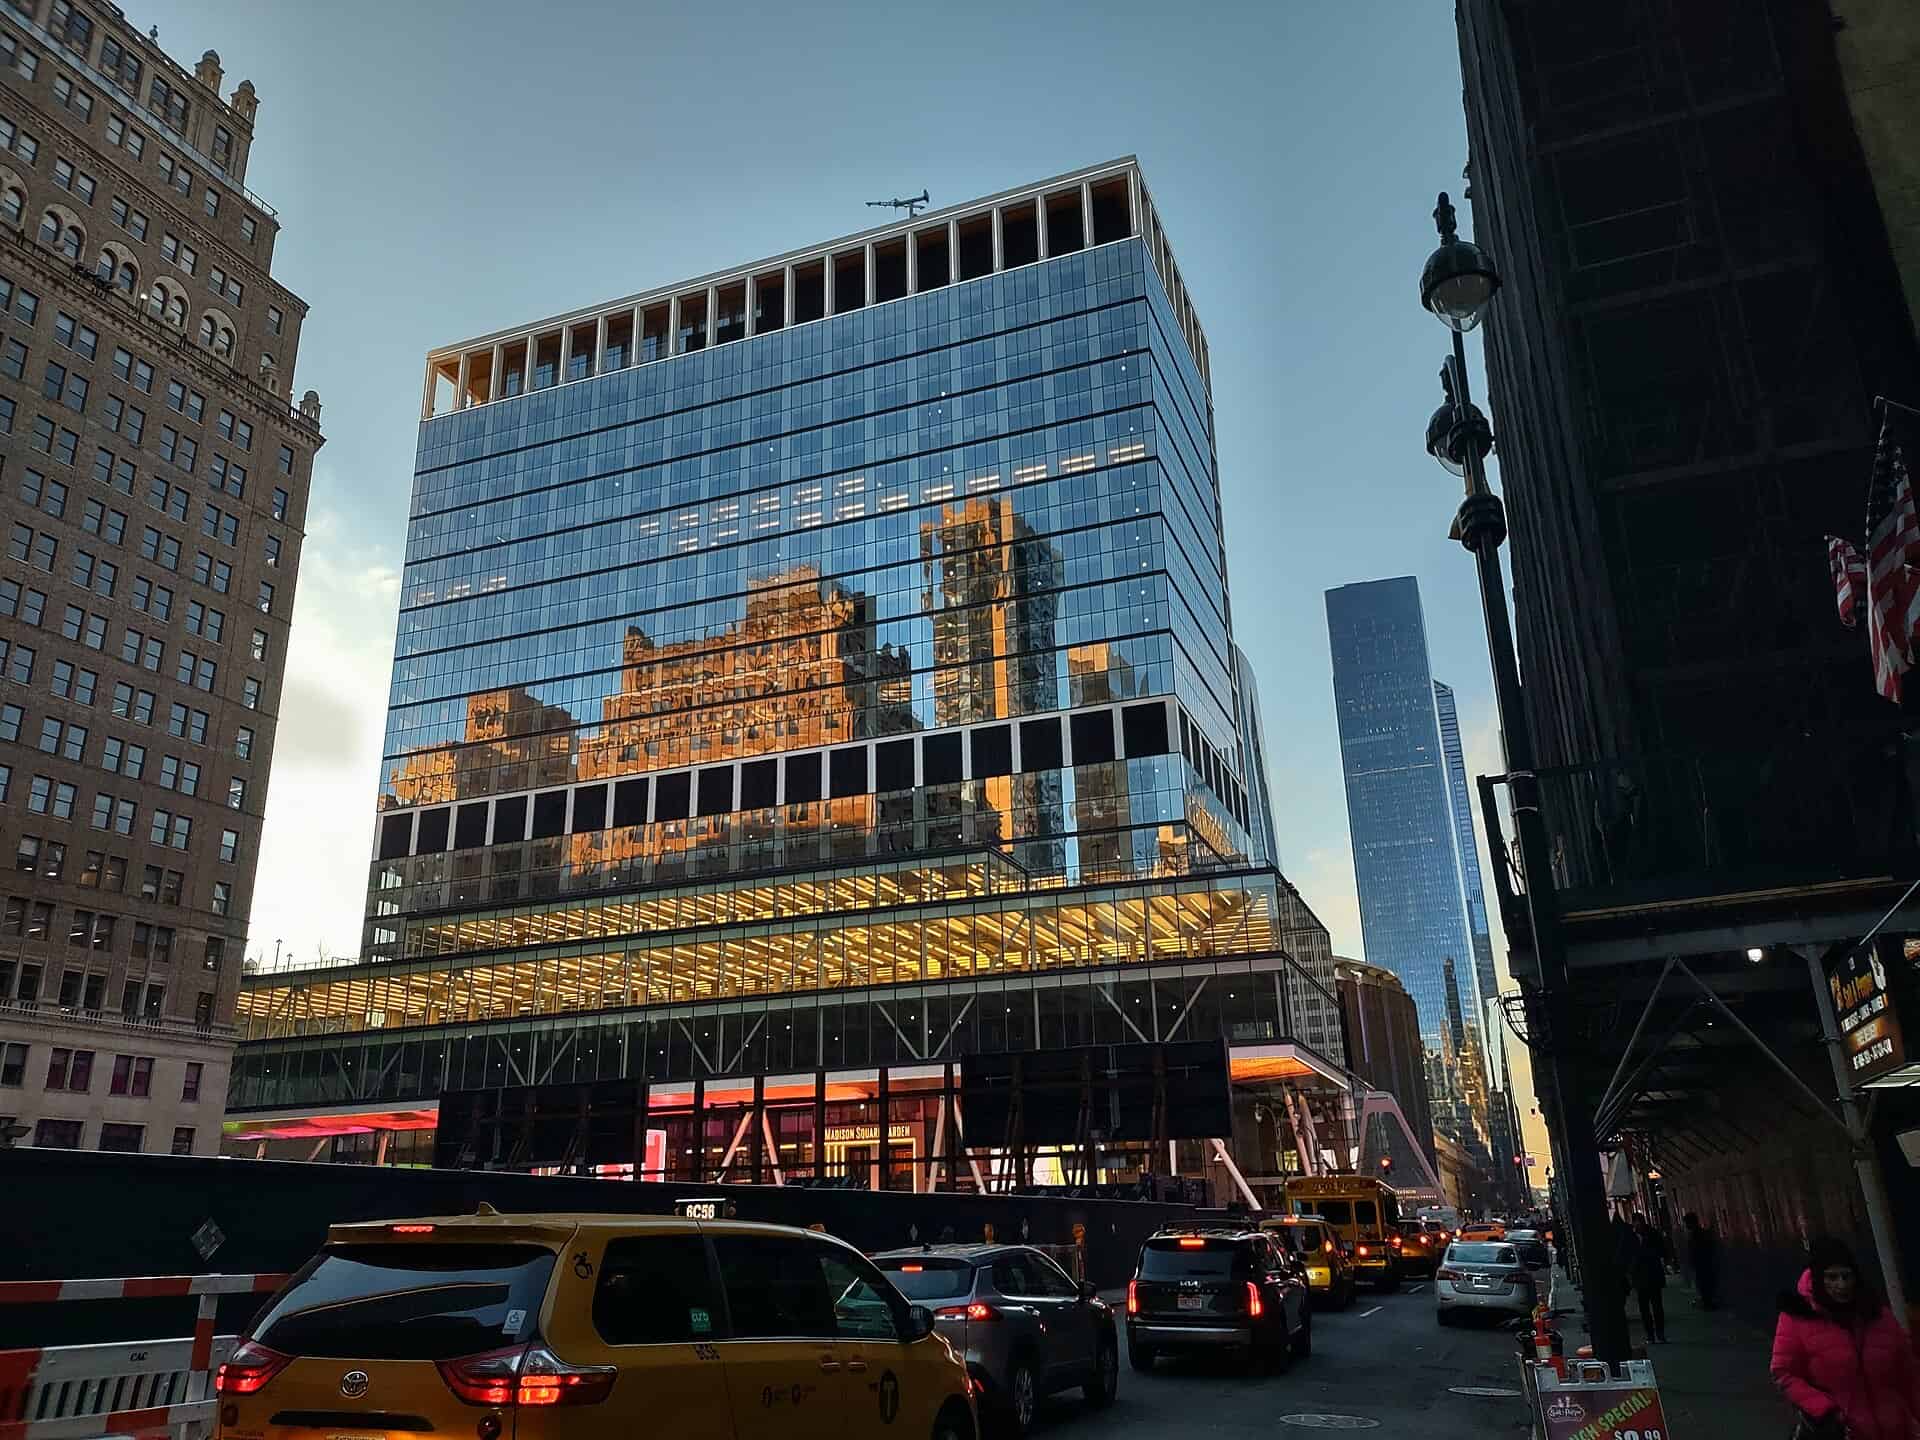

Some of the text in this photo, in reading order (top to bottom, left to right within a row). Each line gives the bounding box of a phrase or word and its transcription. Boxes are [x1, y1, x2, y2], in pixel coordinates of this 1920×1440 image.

[825, 1128, 855, 1141] MADISON
[888, 1126, 910, 1137] ARDEN
[1599, 1391, 1652, 1432] SPECIAL
